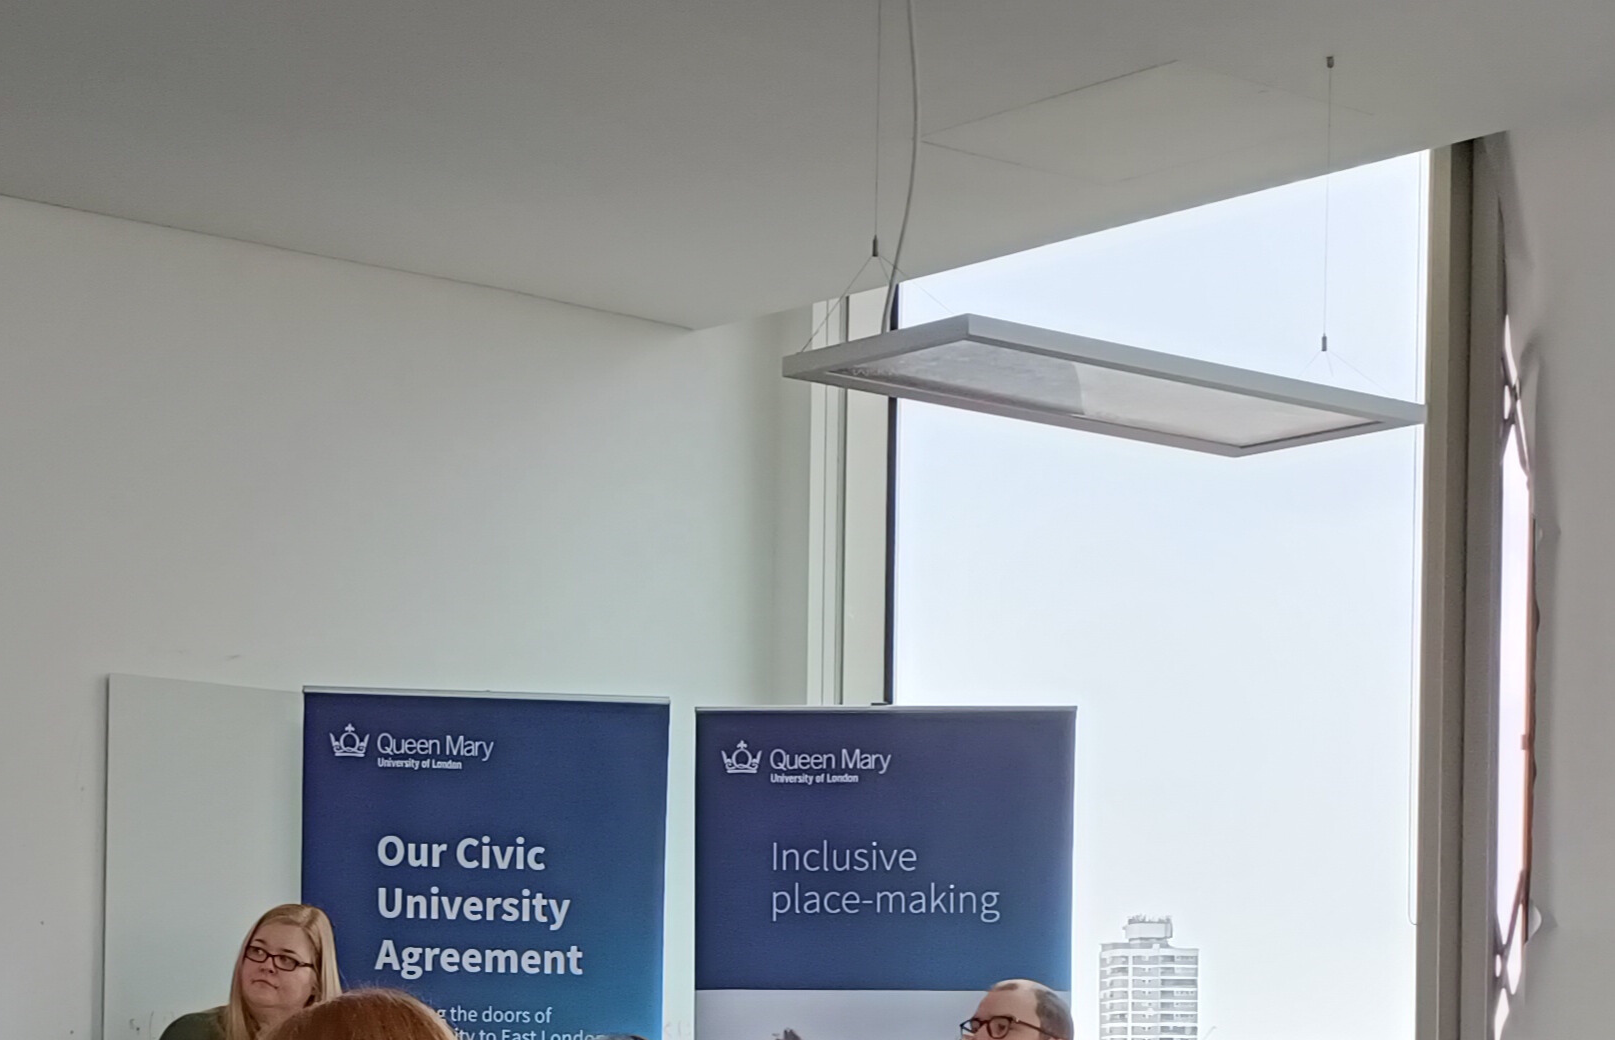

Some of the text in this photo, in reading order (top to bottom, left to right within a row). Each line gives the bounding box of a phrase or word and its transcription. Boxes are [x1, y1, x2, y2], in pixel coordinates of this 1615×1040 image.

[377, 733, 494, 761] Queen Mary
[770, 749, 891, 774] Queen Mary
[377, 758, 462, 770] University of London
[770, 773, 858, 785] University of London
[377, 835, 546, 870] Our Civic
[772, 840, 918, 871] Inclusive
[377, 886, 571, 931] University
[772, 882, 1000, 923] place-making
[375, 939, 583, 980] Agreement
[451, 1006, 478, 1022] the
[482, 1005, 531, 1023] doors
[535, 1007, 553, 1023] of
